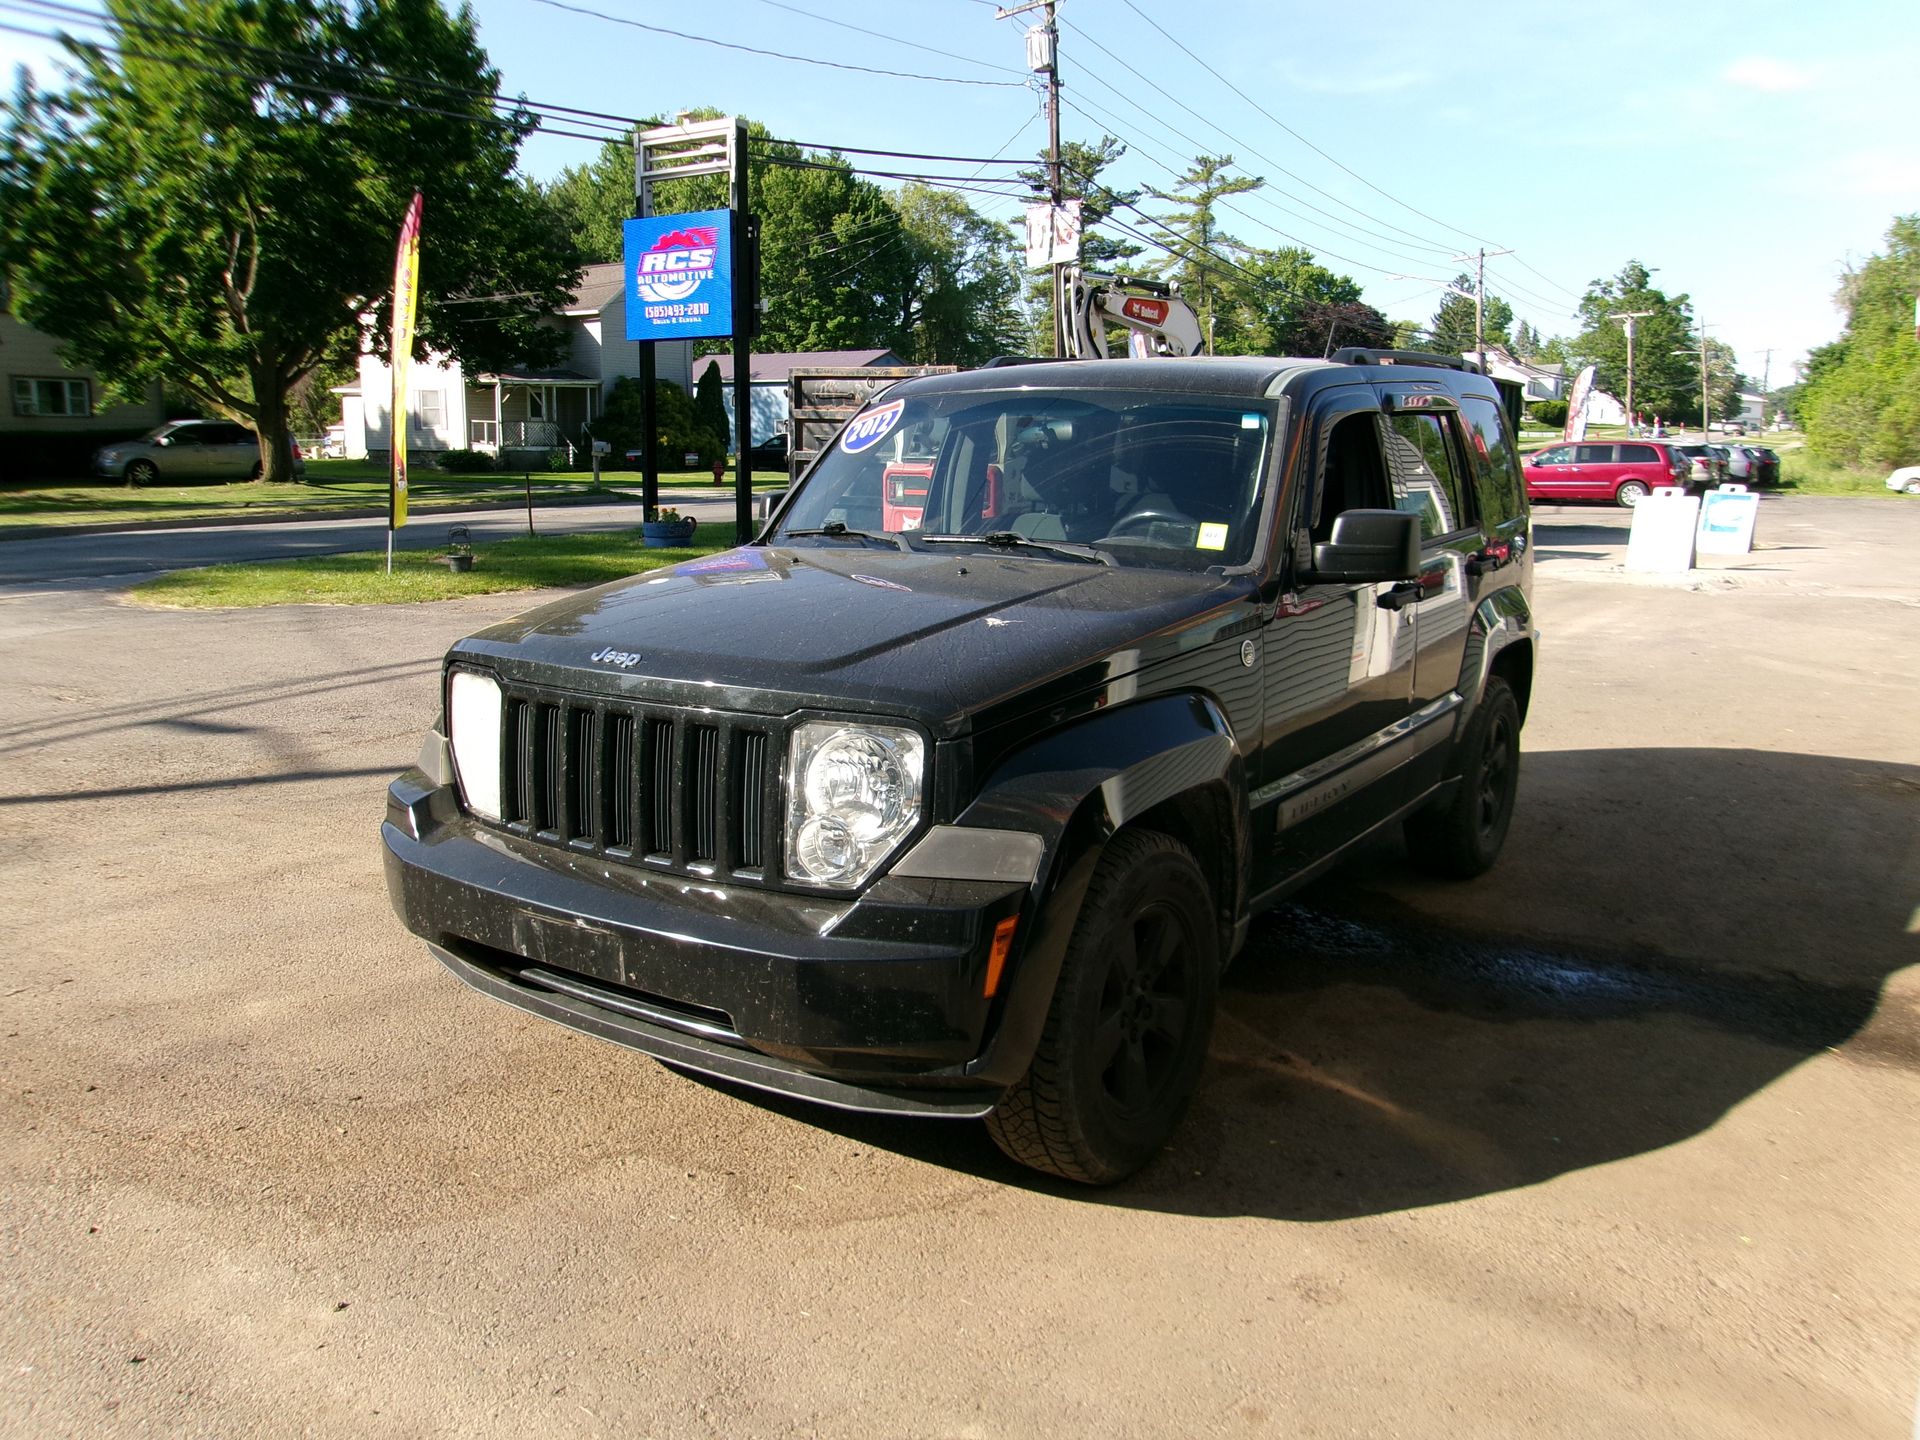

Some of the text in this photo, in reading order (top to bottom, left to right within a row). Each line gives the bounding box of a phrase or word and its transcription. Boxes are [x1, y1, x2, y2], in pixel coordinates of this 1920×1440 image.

[641, 248, 714, 272] RCS
[637, 270, 714, 285] AUTOMOTIVE
[846, 412, 893, 444] 2012
[591, 647, 642, 668] Jeep
